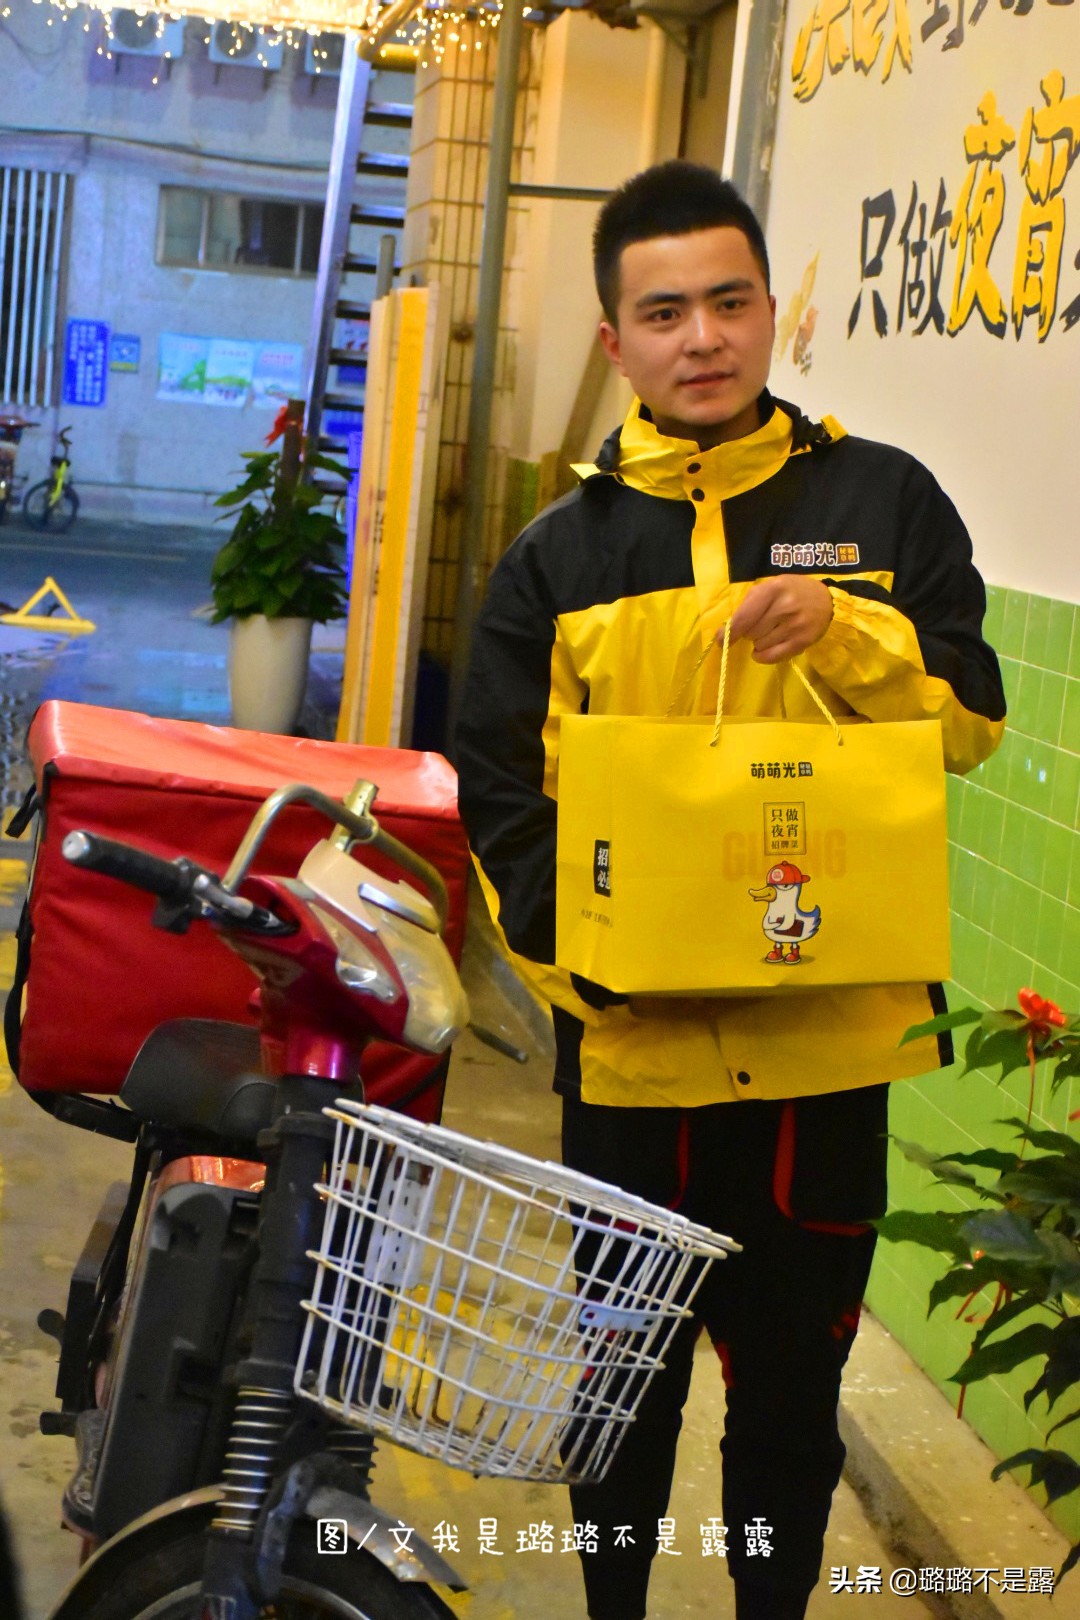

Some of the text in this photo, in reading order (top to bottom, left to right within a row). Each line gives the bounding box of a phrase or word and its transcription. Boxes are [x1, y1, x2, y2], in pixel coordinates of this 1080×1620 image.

[847, 68, 1080, 344] 只做夜宵
[770, 808, 800, 823] 只做
[770, 824, 800, 838] 夜宵
